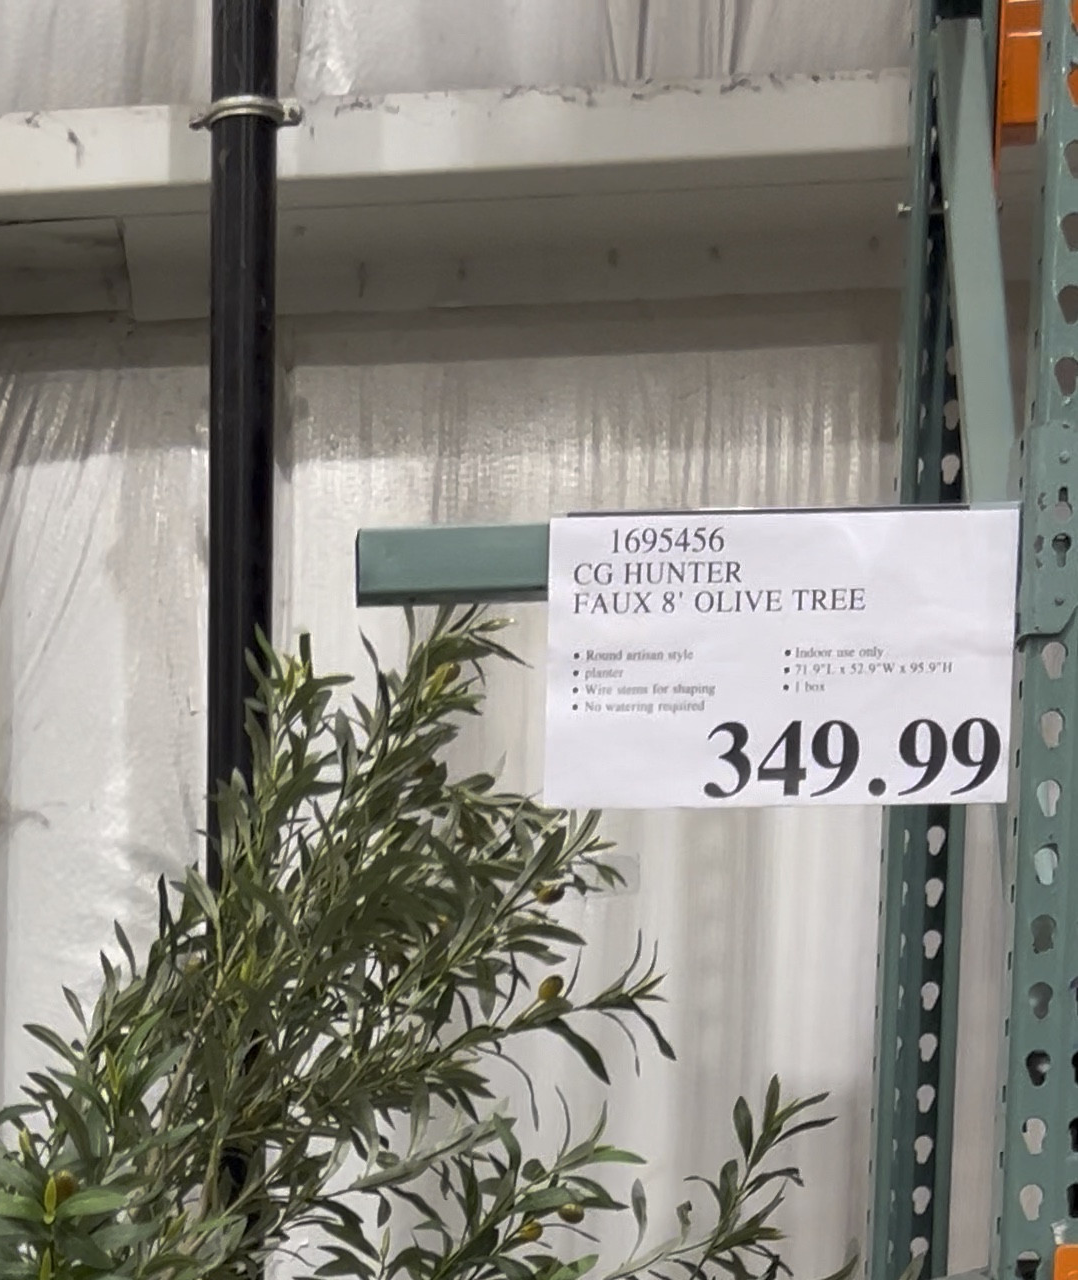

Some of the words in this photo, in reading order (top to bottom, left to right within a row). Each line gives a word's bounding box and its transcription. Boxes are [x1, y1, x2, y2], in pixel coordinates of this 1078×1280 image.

[612, 527, 725, 554] 1695456
[573, 563, 613, 585] CG
[623, 561, 742, 584] HUNTER
[573, 592, 652, 614] FAUX
[661, 591, 684, 613] 8'
[694, 590, 783, 613] OLIVE
[792, 588, 867, 611] TREE
[586, 649, 623, 661] Round
[626, 649, 664, 661] artisan
[668, 649, 694, 663] style
[795, 647, 833, 658] Indoor
[836, 649, 855, 658] use
[859, 646, 885, 660] only
[585, 667, 624, 681] planter
[585, 684, 612, 695] Wire
[653, 683, 668, 694] for
[673, 683, 716, 697] shaping
[805, 681, 826, 692] box
[585, 701, 602, 712] No
[606, 701, 653, 714] watering
[658, 701, 705, 714] required
[703, 717, 1002, 798] 349.99
